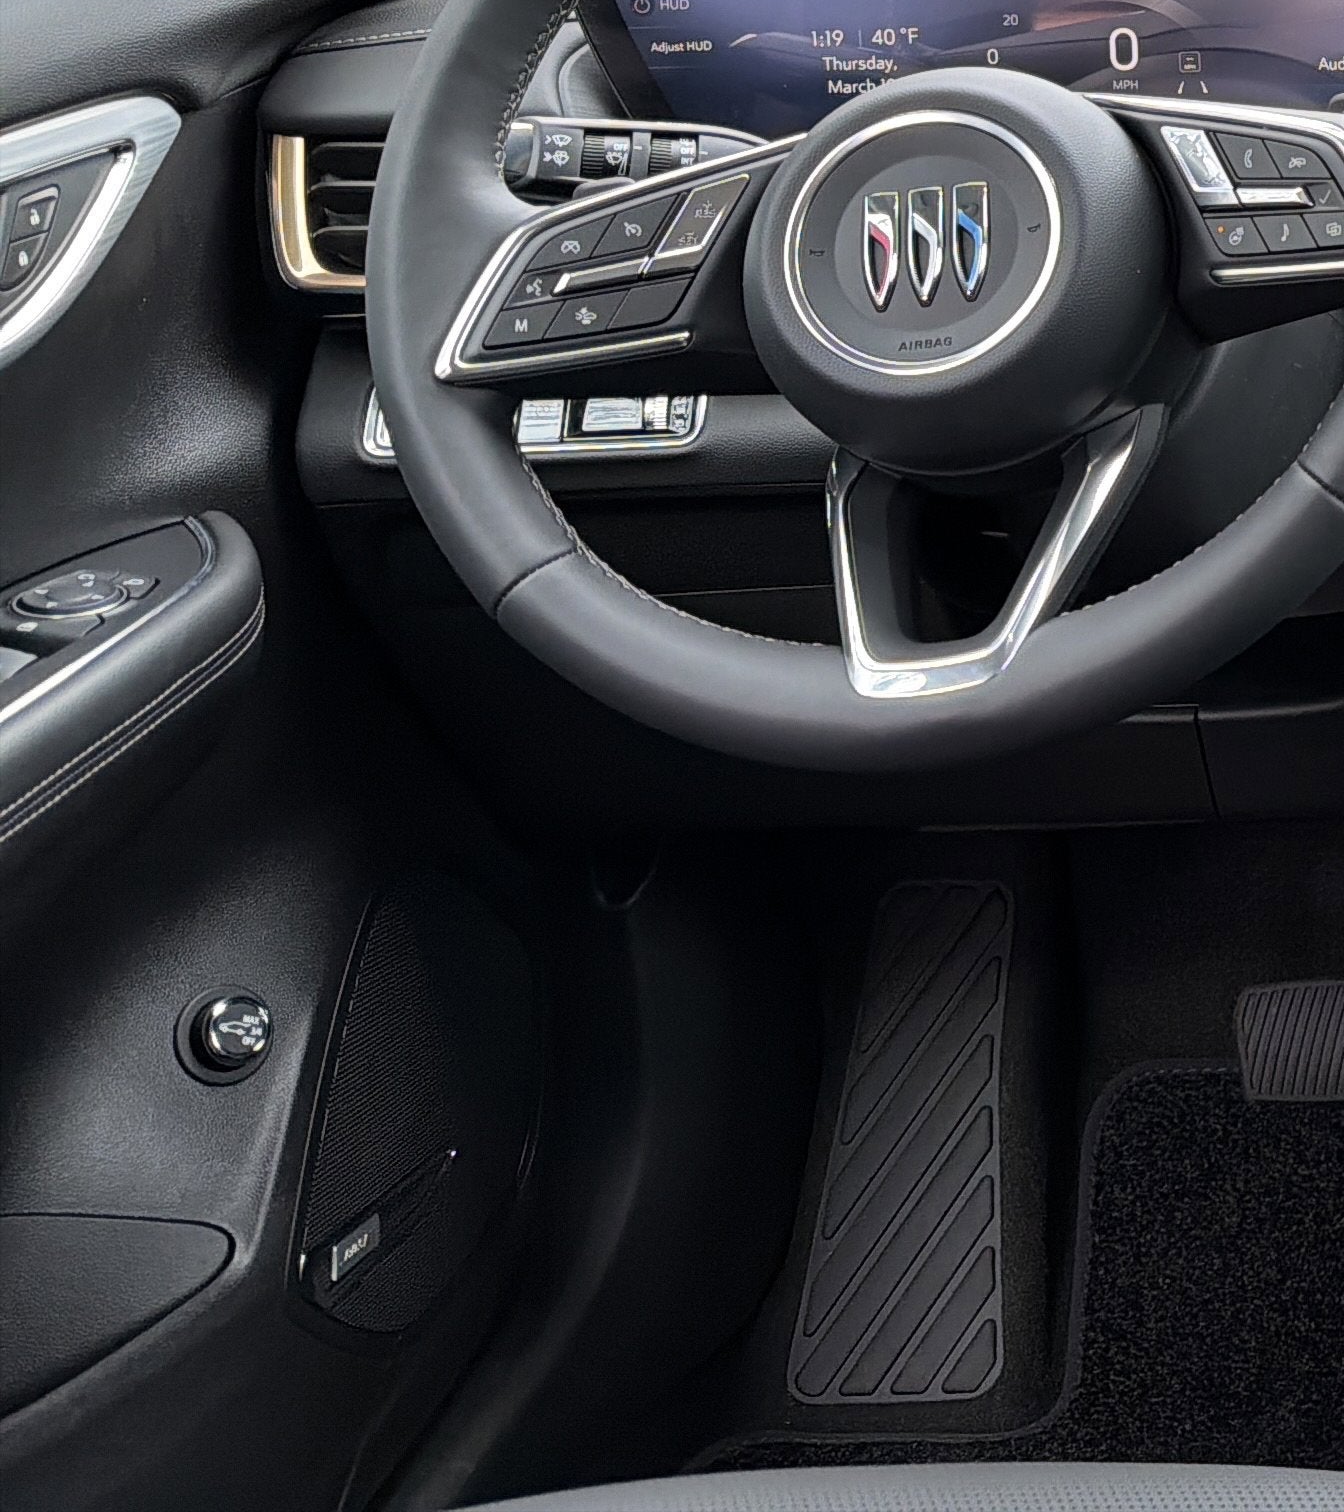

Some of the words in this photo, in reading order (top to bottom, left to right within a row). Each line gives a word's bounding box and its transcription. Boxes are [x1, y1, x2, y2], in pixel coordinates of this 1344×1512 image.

[1002, 13, 1019, 27] 20
[811, 29, 844, 47] 1:19
[871, 29, 896, 46] 40
[650, 39, 684, 54] Adjust
[686, 40, 713, 53] HUD
[1108, 27, 1140, 72] 0
[821, 55, 898, 73] Thursday,
[986, 49, 999, 65] 0
[828, 79, 876, 94] March
[1112, 79, 1139, 91] MPH
[613, 143, 629, 152] OFF
[514, 318, 529, 334] M
[898, 336, 953, 353] AIRBAG
[241, 1036, 257, 1046] OFF
